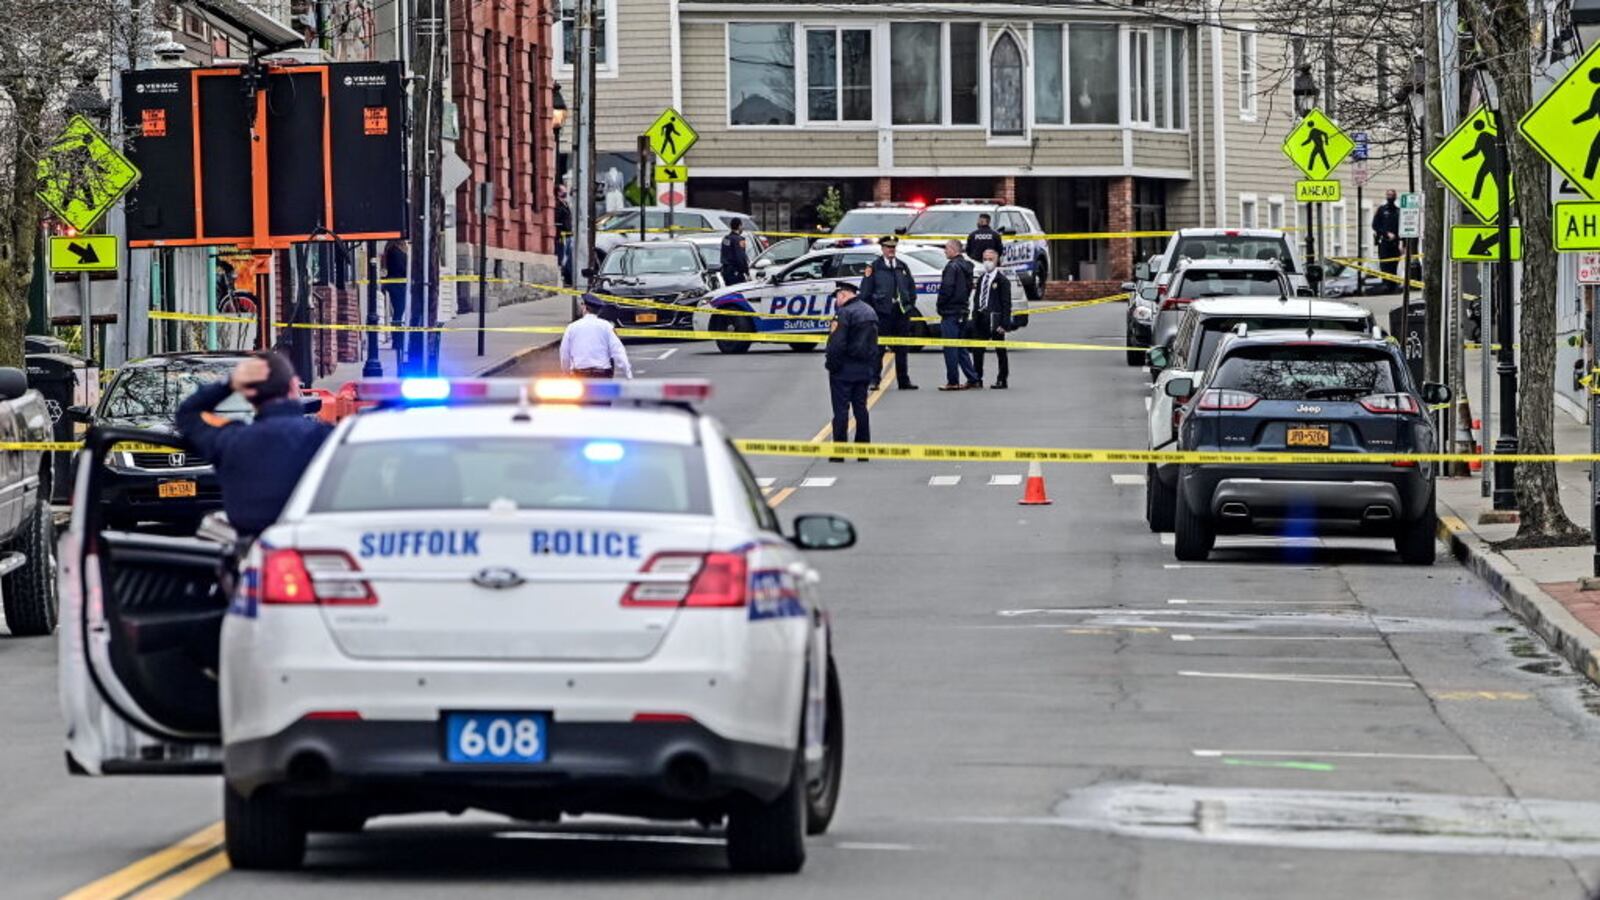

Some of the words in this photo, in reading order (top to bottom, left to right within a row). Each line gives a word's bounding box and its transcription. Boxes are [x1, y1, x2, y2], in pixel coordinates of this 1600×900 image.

[1301, 185, 1335, 196] AHEAD
[1566, 214, 1597, 237] AH
[1002, 244, 1032, 263] POLICE
[769, 294, 838, 316] POLI
[783, 319, 816, 329] Suffolk
[818, 319, 831, 328] Co
[1296, 404, 1321, 414] Jeep
[360, 530, 480, 558] SUFFOLK
[531, 530, 641, 559] POLICE
[459, 719, 540, 757] 608
